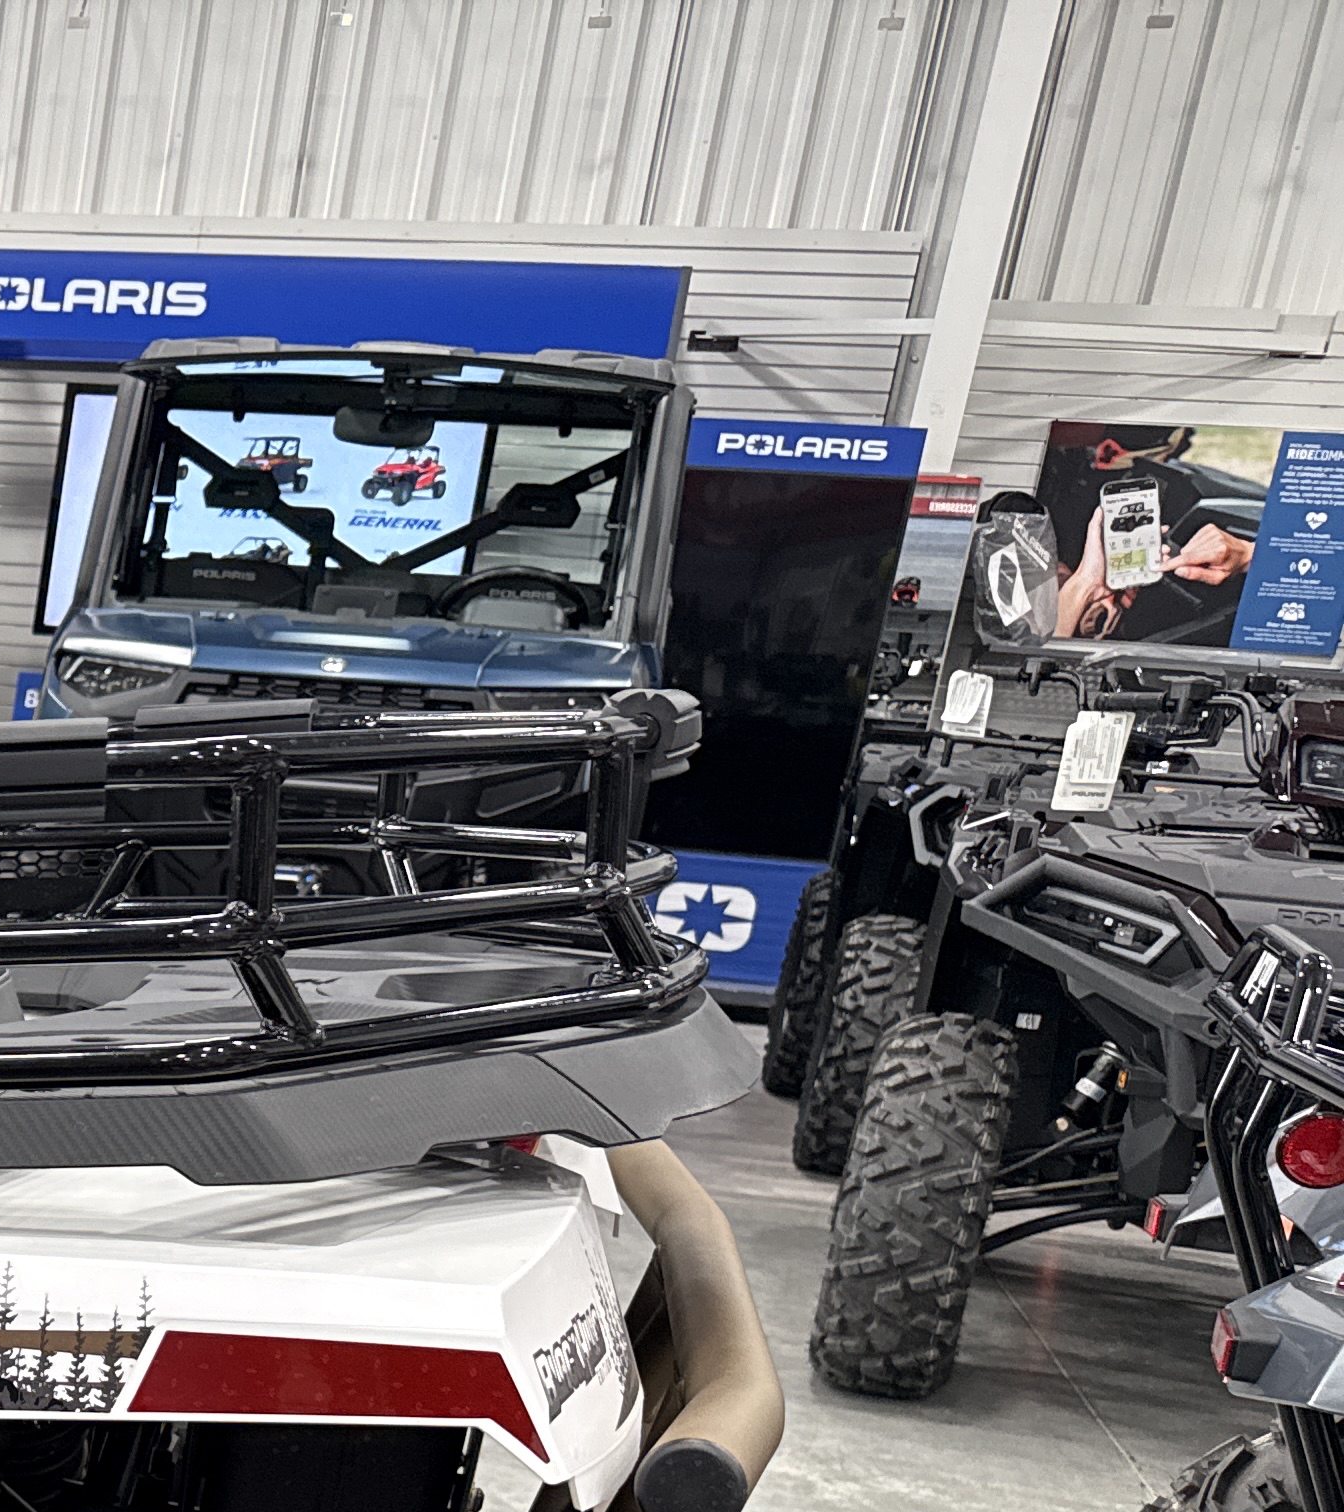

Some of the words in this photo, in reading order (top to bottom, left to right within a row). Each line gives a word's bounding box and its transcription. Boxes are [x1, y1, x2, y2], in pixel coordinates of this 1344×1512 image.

[715, 432, 889, 462] POLARIS
[348, 514, 443, 531] GENERAL
[192, 567, 256, 582] POLARIS
[489, 588, 556, 601] POLARIS
